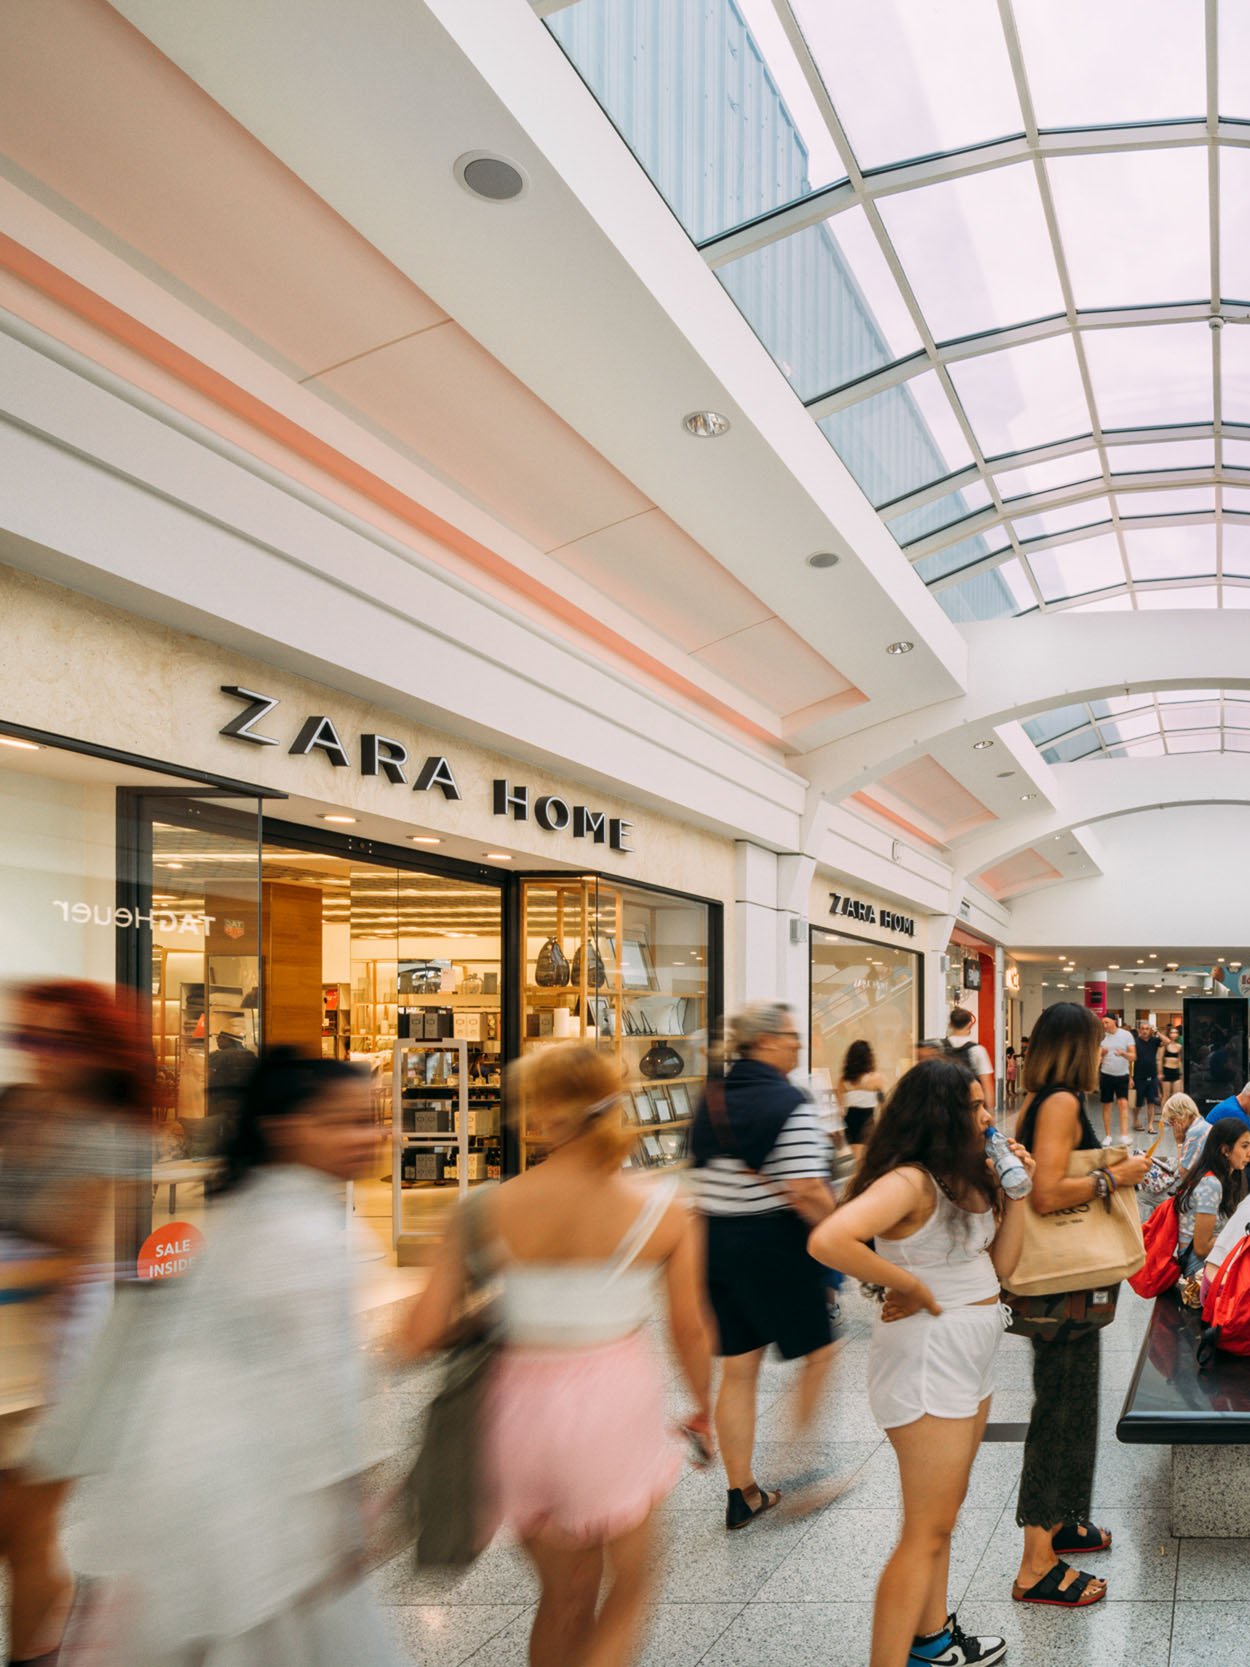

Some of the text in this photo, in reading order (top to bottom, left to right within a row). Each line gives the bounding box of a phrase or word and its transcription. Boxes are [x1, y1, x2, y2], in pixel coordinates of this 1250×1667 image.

[219, 685, 636, 853] ZARA HOME
[829, 892, 876, 924] ZARA
[155, 1239, 191, 1258] SALE
